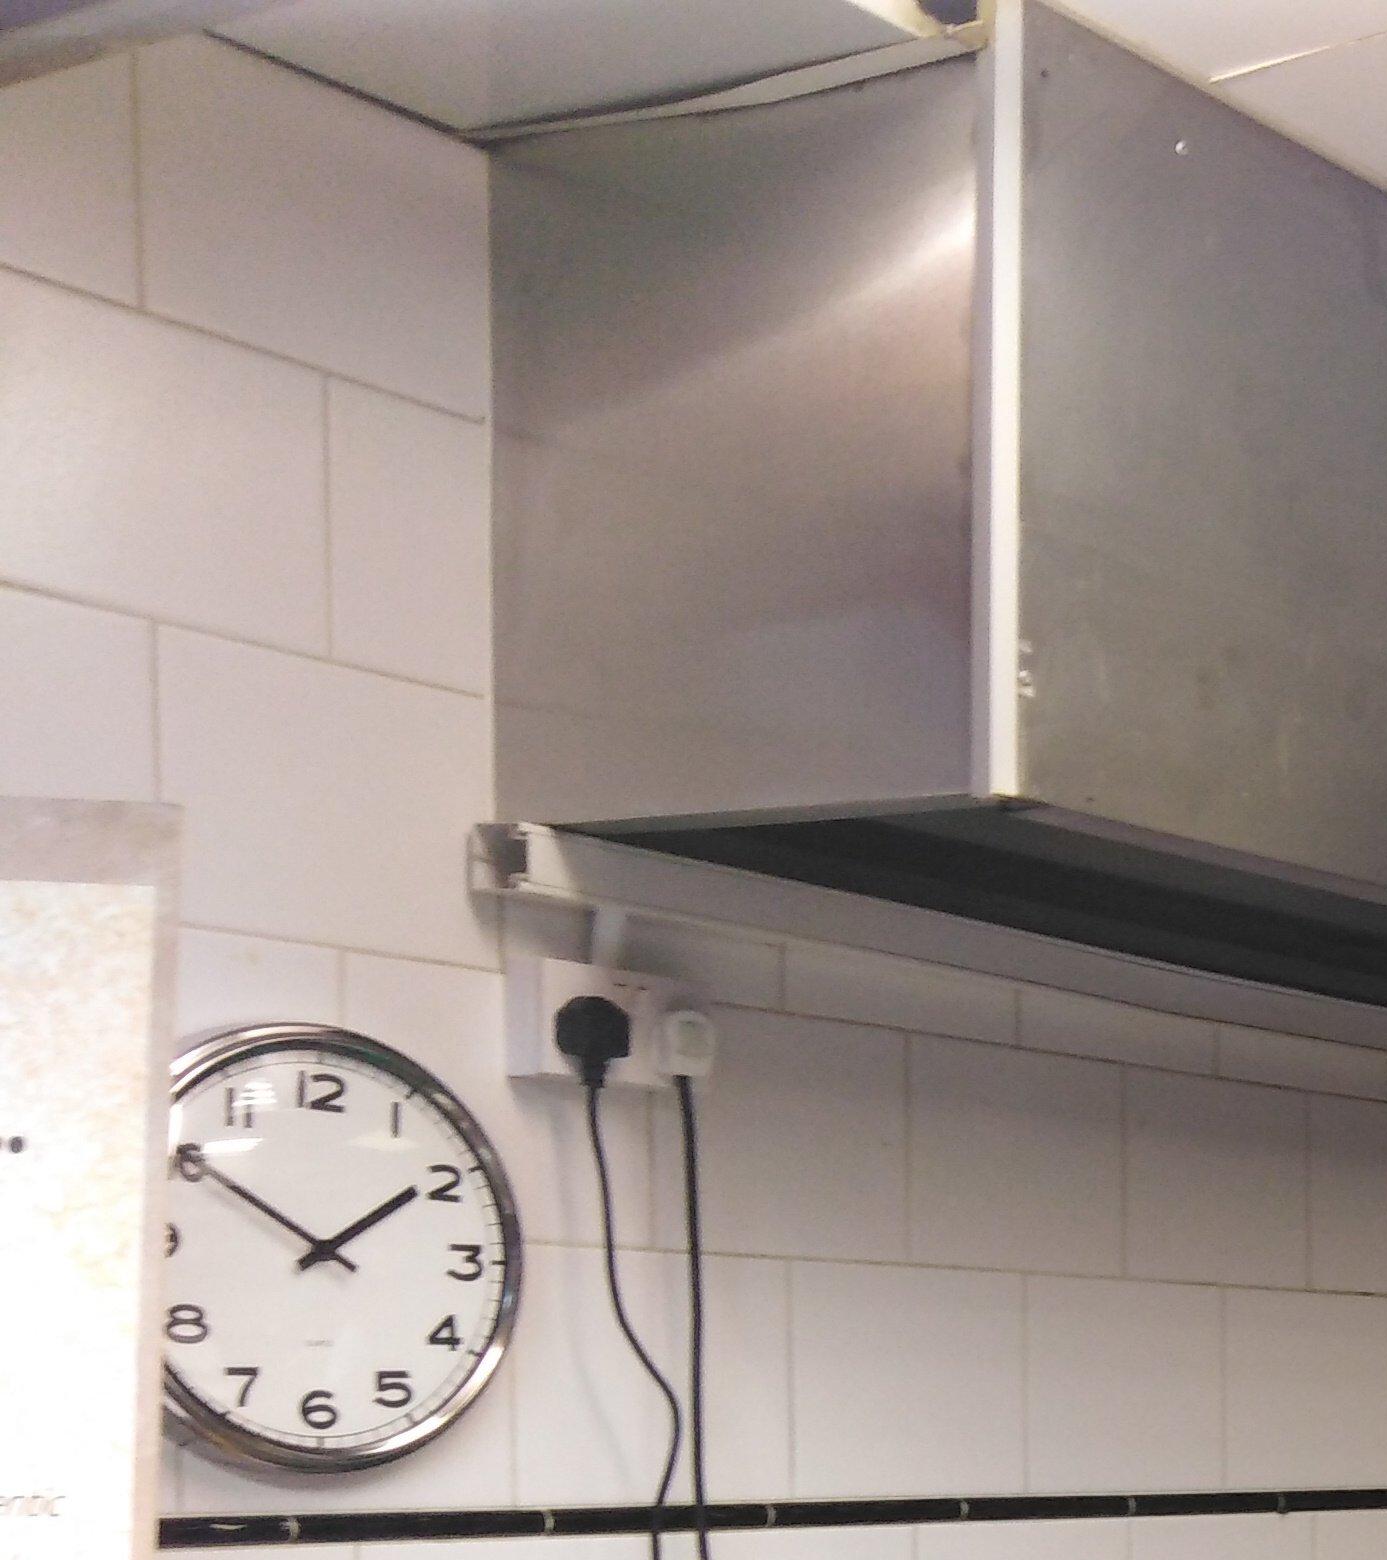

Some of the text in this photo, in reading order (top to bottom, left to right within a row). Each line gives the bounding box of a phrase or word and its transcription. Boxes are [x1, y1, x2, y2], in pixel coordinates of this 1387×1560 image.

[298, 1070, 345, 1113] 12
[390, 1101, 401, 1138] 1
[427, 1164, 463, 1203] 2
[447, 1243, 483, 1283] 3
[165, 1304, 208, 1344] 8
[428, 1314, 462, 1352] 4
[225, 1366, 259, 1408] 7
[375, 1370, 414, 1409] 5
[300, 1389, 338, 1430] 6
